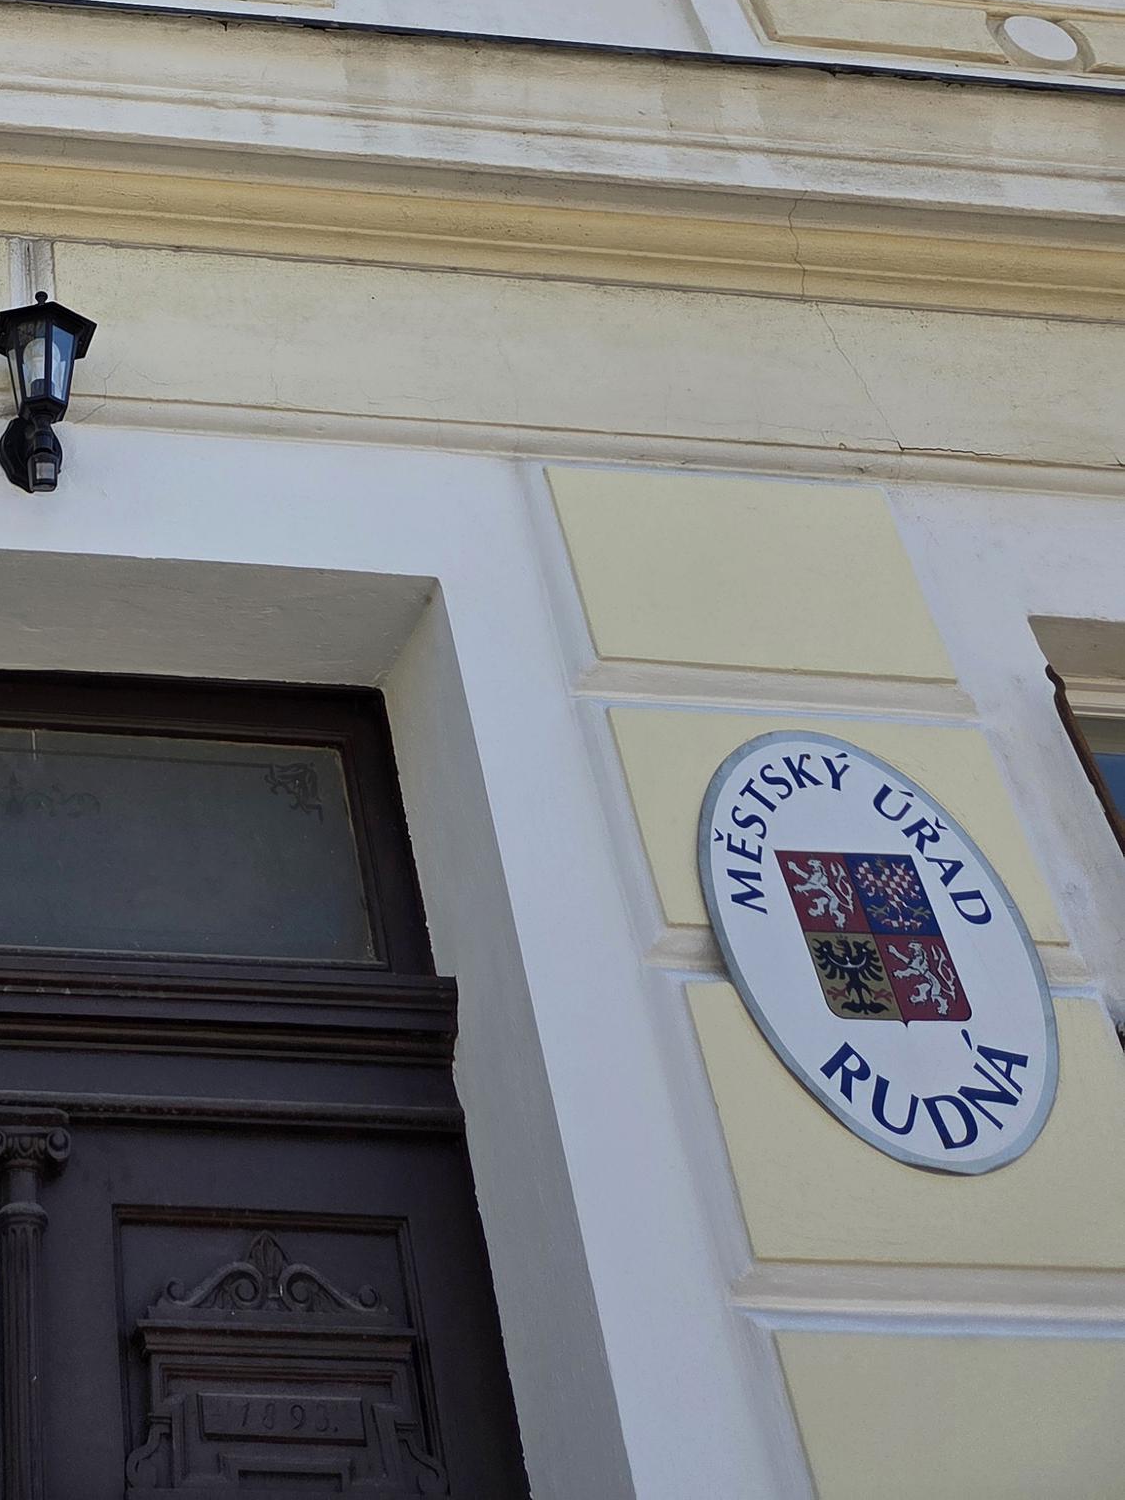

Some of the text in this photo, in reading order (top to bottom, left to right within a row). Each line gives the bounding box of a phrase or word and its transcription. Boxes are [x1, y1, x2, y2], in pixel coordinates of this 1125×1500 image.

[714, 751, 993, 926] MĚSTSKÝ ÚŘAD
[820, 1029, 1029, 1150] RUDNÁ
